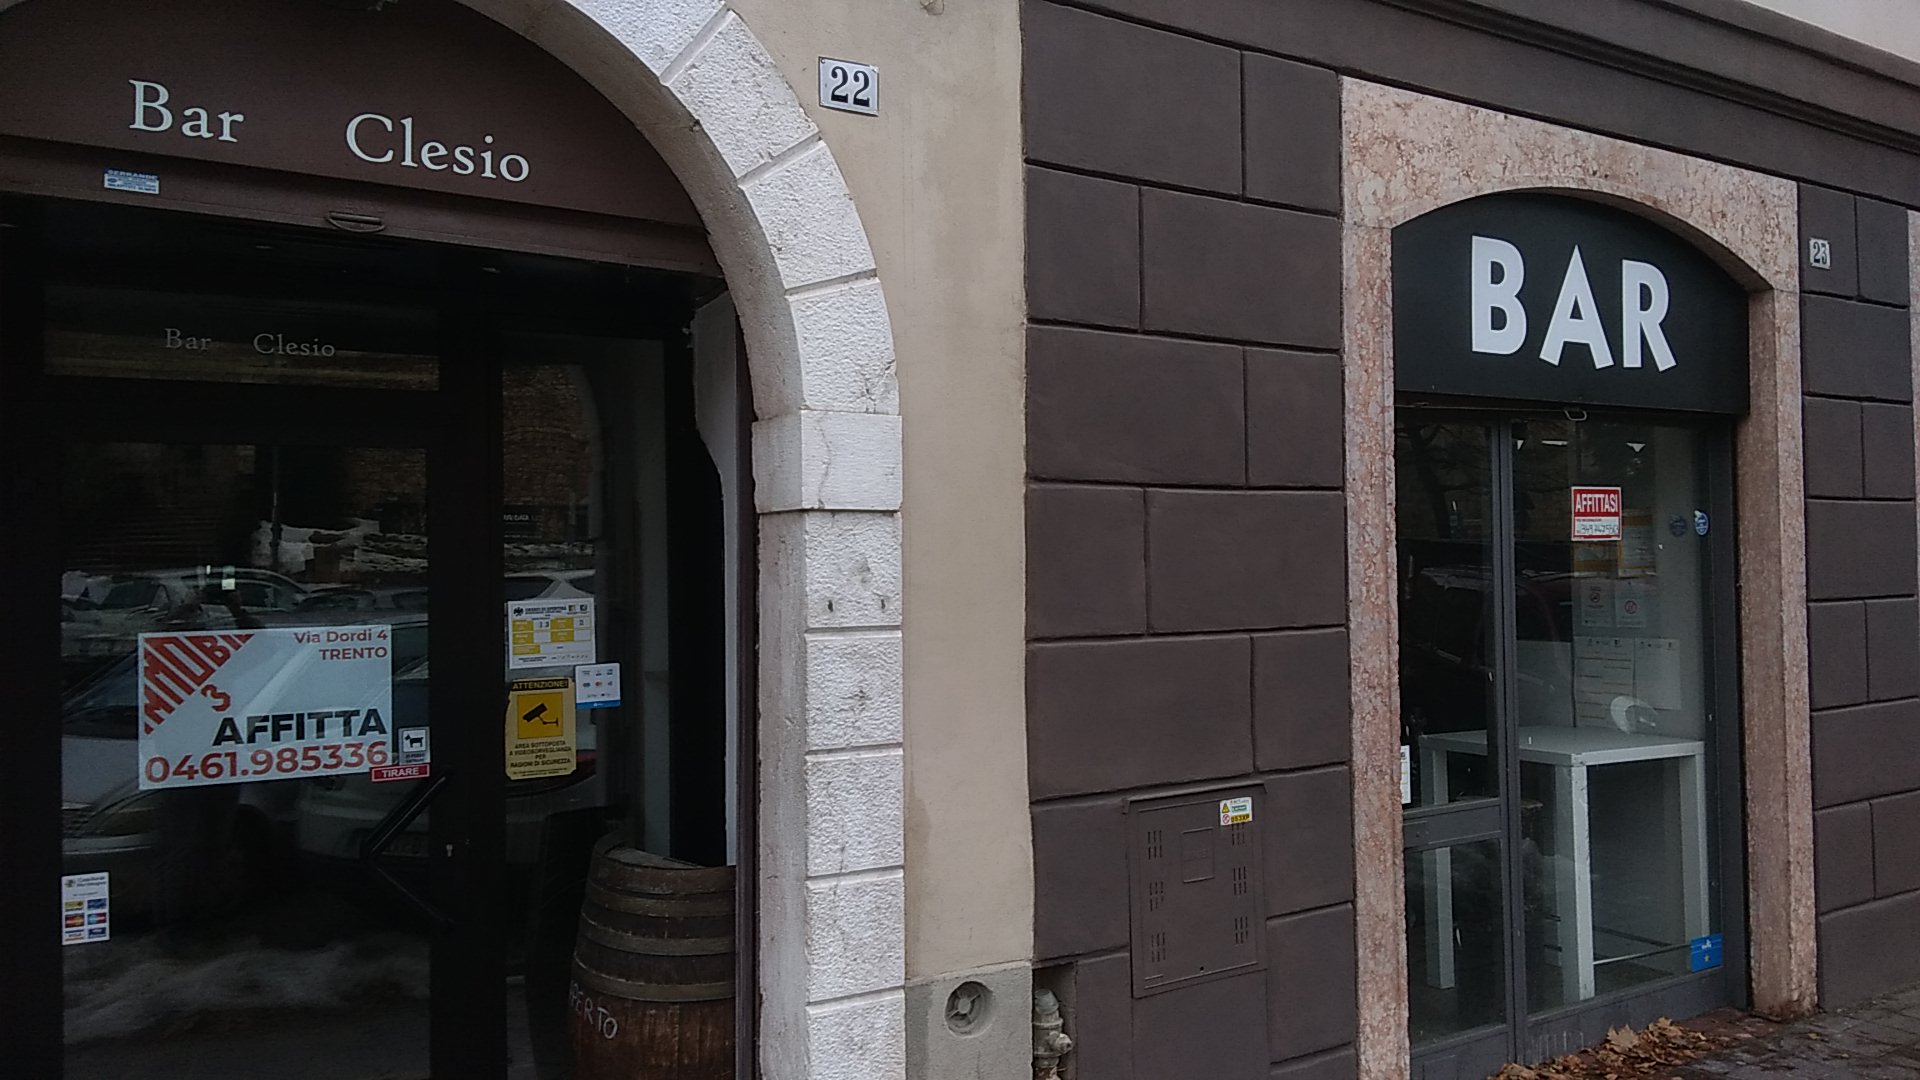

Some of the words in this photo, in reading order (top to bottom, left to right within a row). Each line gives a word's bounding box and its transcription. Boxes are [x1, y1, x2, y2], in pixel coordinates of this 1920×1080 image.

[830, 66, 870, 107] 22
[129, 79, 244, 143] Bar
[346, 113, 530, 182] Clesio
[1813, 241, 1828, 265] 23
[1472, 235, 1677, 372] BAR
[165, 328, 211, 350] Bar
[253, 333, 335, 357] Clesio
[1575, 493, 1618, 513] AFFITTASI
[294, 631, 321, 644] Via
[326, 629, 372, 642] Dordi
[377, 629, 389, 641] 4
[319, 646, 388, 660] TRENTO
[512, 680, 568, 690] ATTENZIONE!
[212, 708, 388, 746] AFFITTA
[145, 741, 388, 783] 0461.985336
[381, 767, 420, 778] TIRARE
